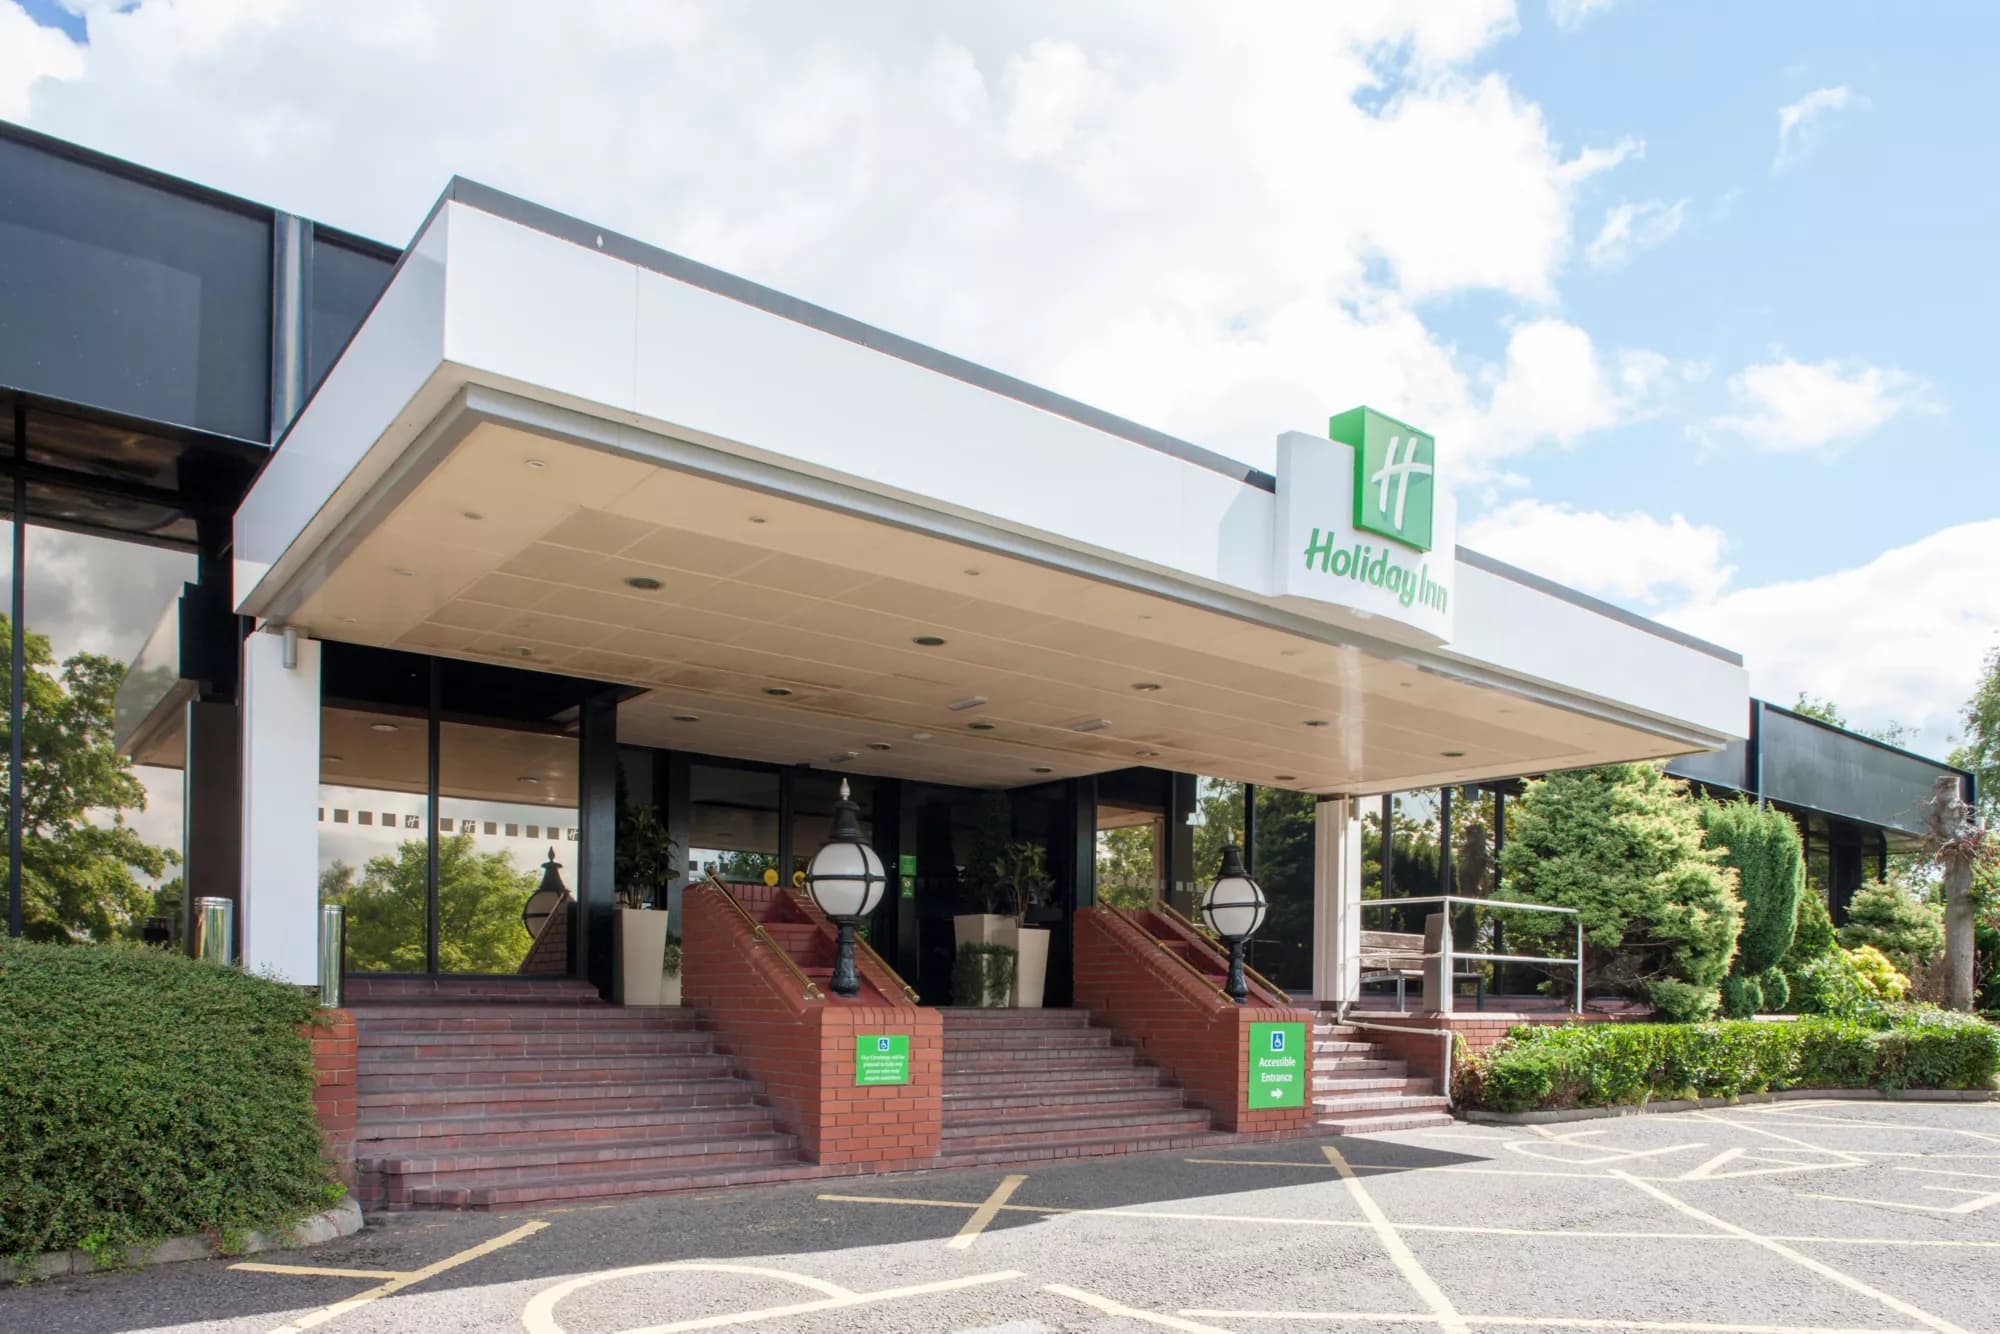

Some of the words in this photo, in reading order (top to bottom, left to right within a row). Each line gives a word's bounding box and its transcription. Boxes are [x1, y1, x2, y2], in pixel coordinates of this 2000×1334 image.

[1304, 528, 1418, 608] Holiday
[1419, 564, 1448, 614] Inn
[1259, 1056, 1296, 1067] Accessible
[1261, 1072, 1293, 1082] Entrance
